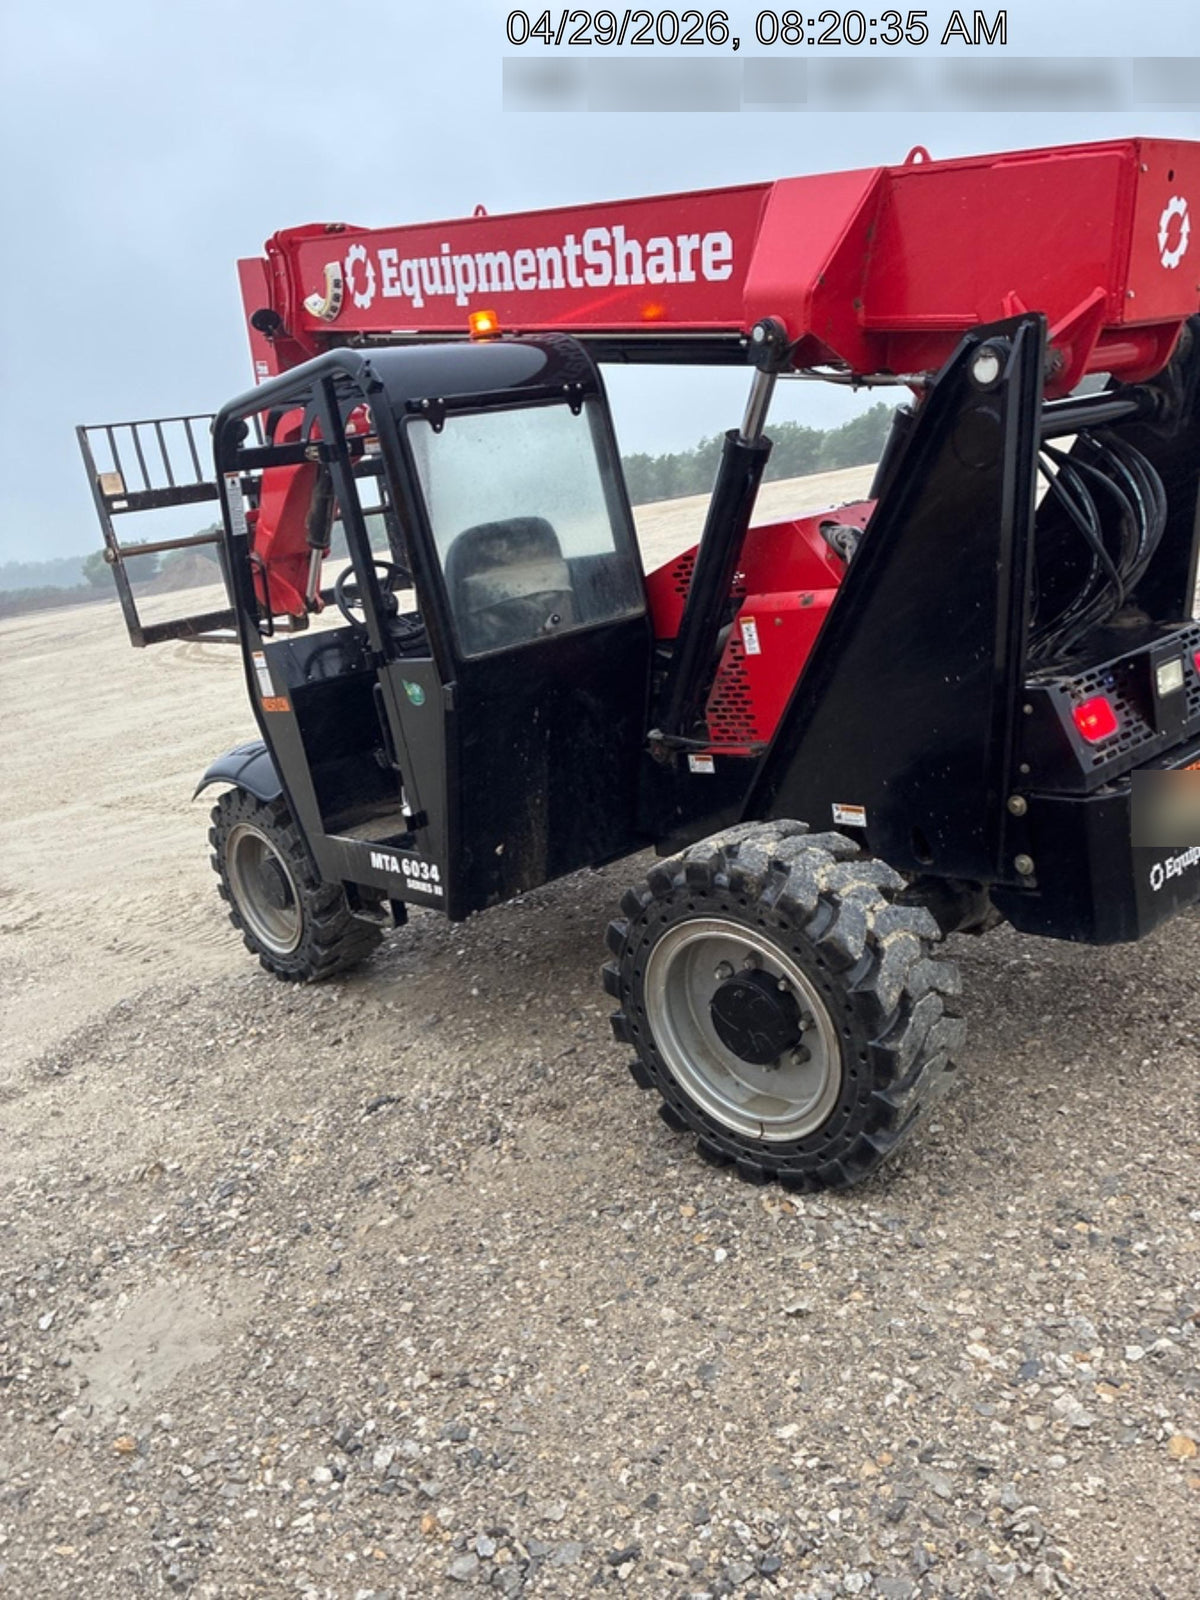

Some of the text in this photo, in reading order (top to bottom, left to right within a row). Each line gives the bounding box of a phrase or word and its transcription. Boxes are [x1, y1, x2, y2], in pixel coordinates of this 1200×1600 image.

[378, 225, 733, 308] EquipmentShare
[370, 851, 440, 882] MTA 6034
